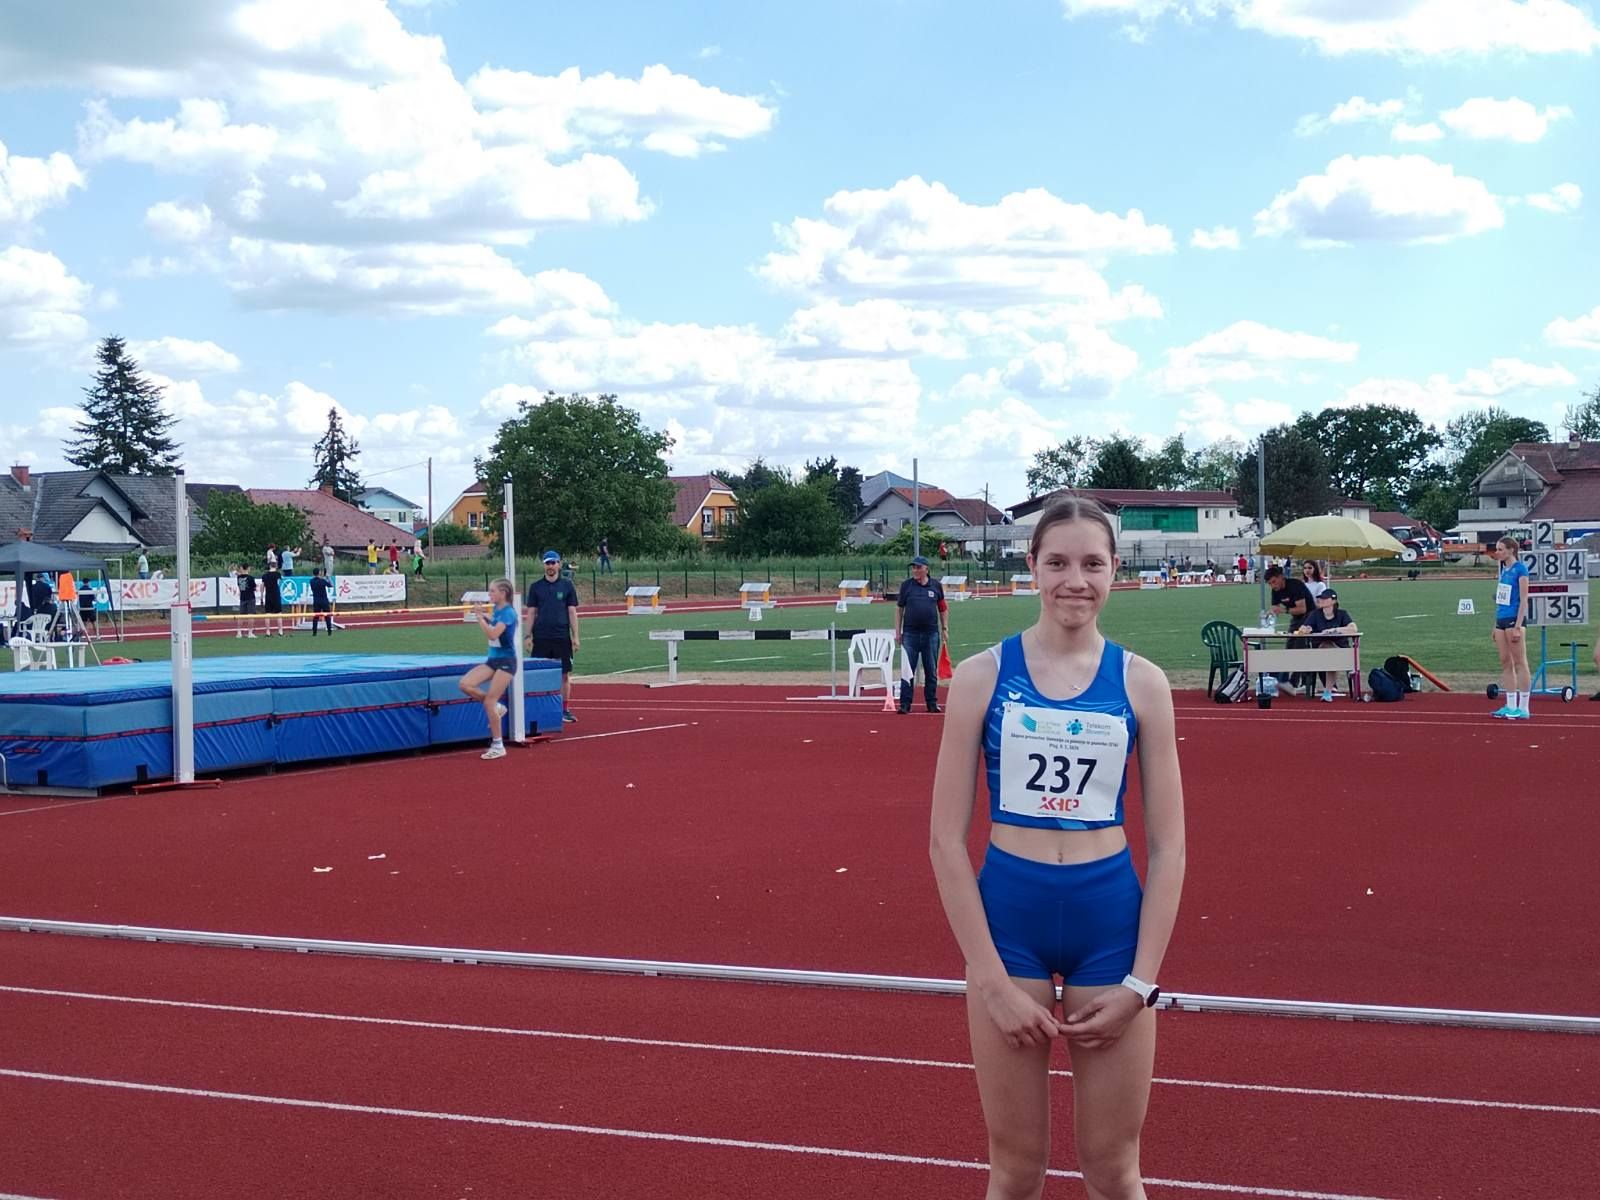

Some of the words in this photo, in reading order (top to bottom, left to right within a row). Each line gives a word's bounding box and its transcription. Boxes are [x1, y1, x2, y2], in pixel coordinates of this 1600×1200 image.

[1538, 522, 1552, 545] 2
[1460, 603, 1471, 611] 30
[1025, 753, 1097, 795] 237
